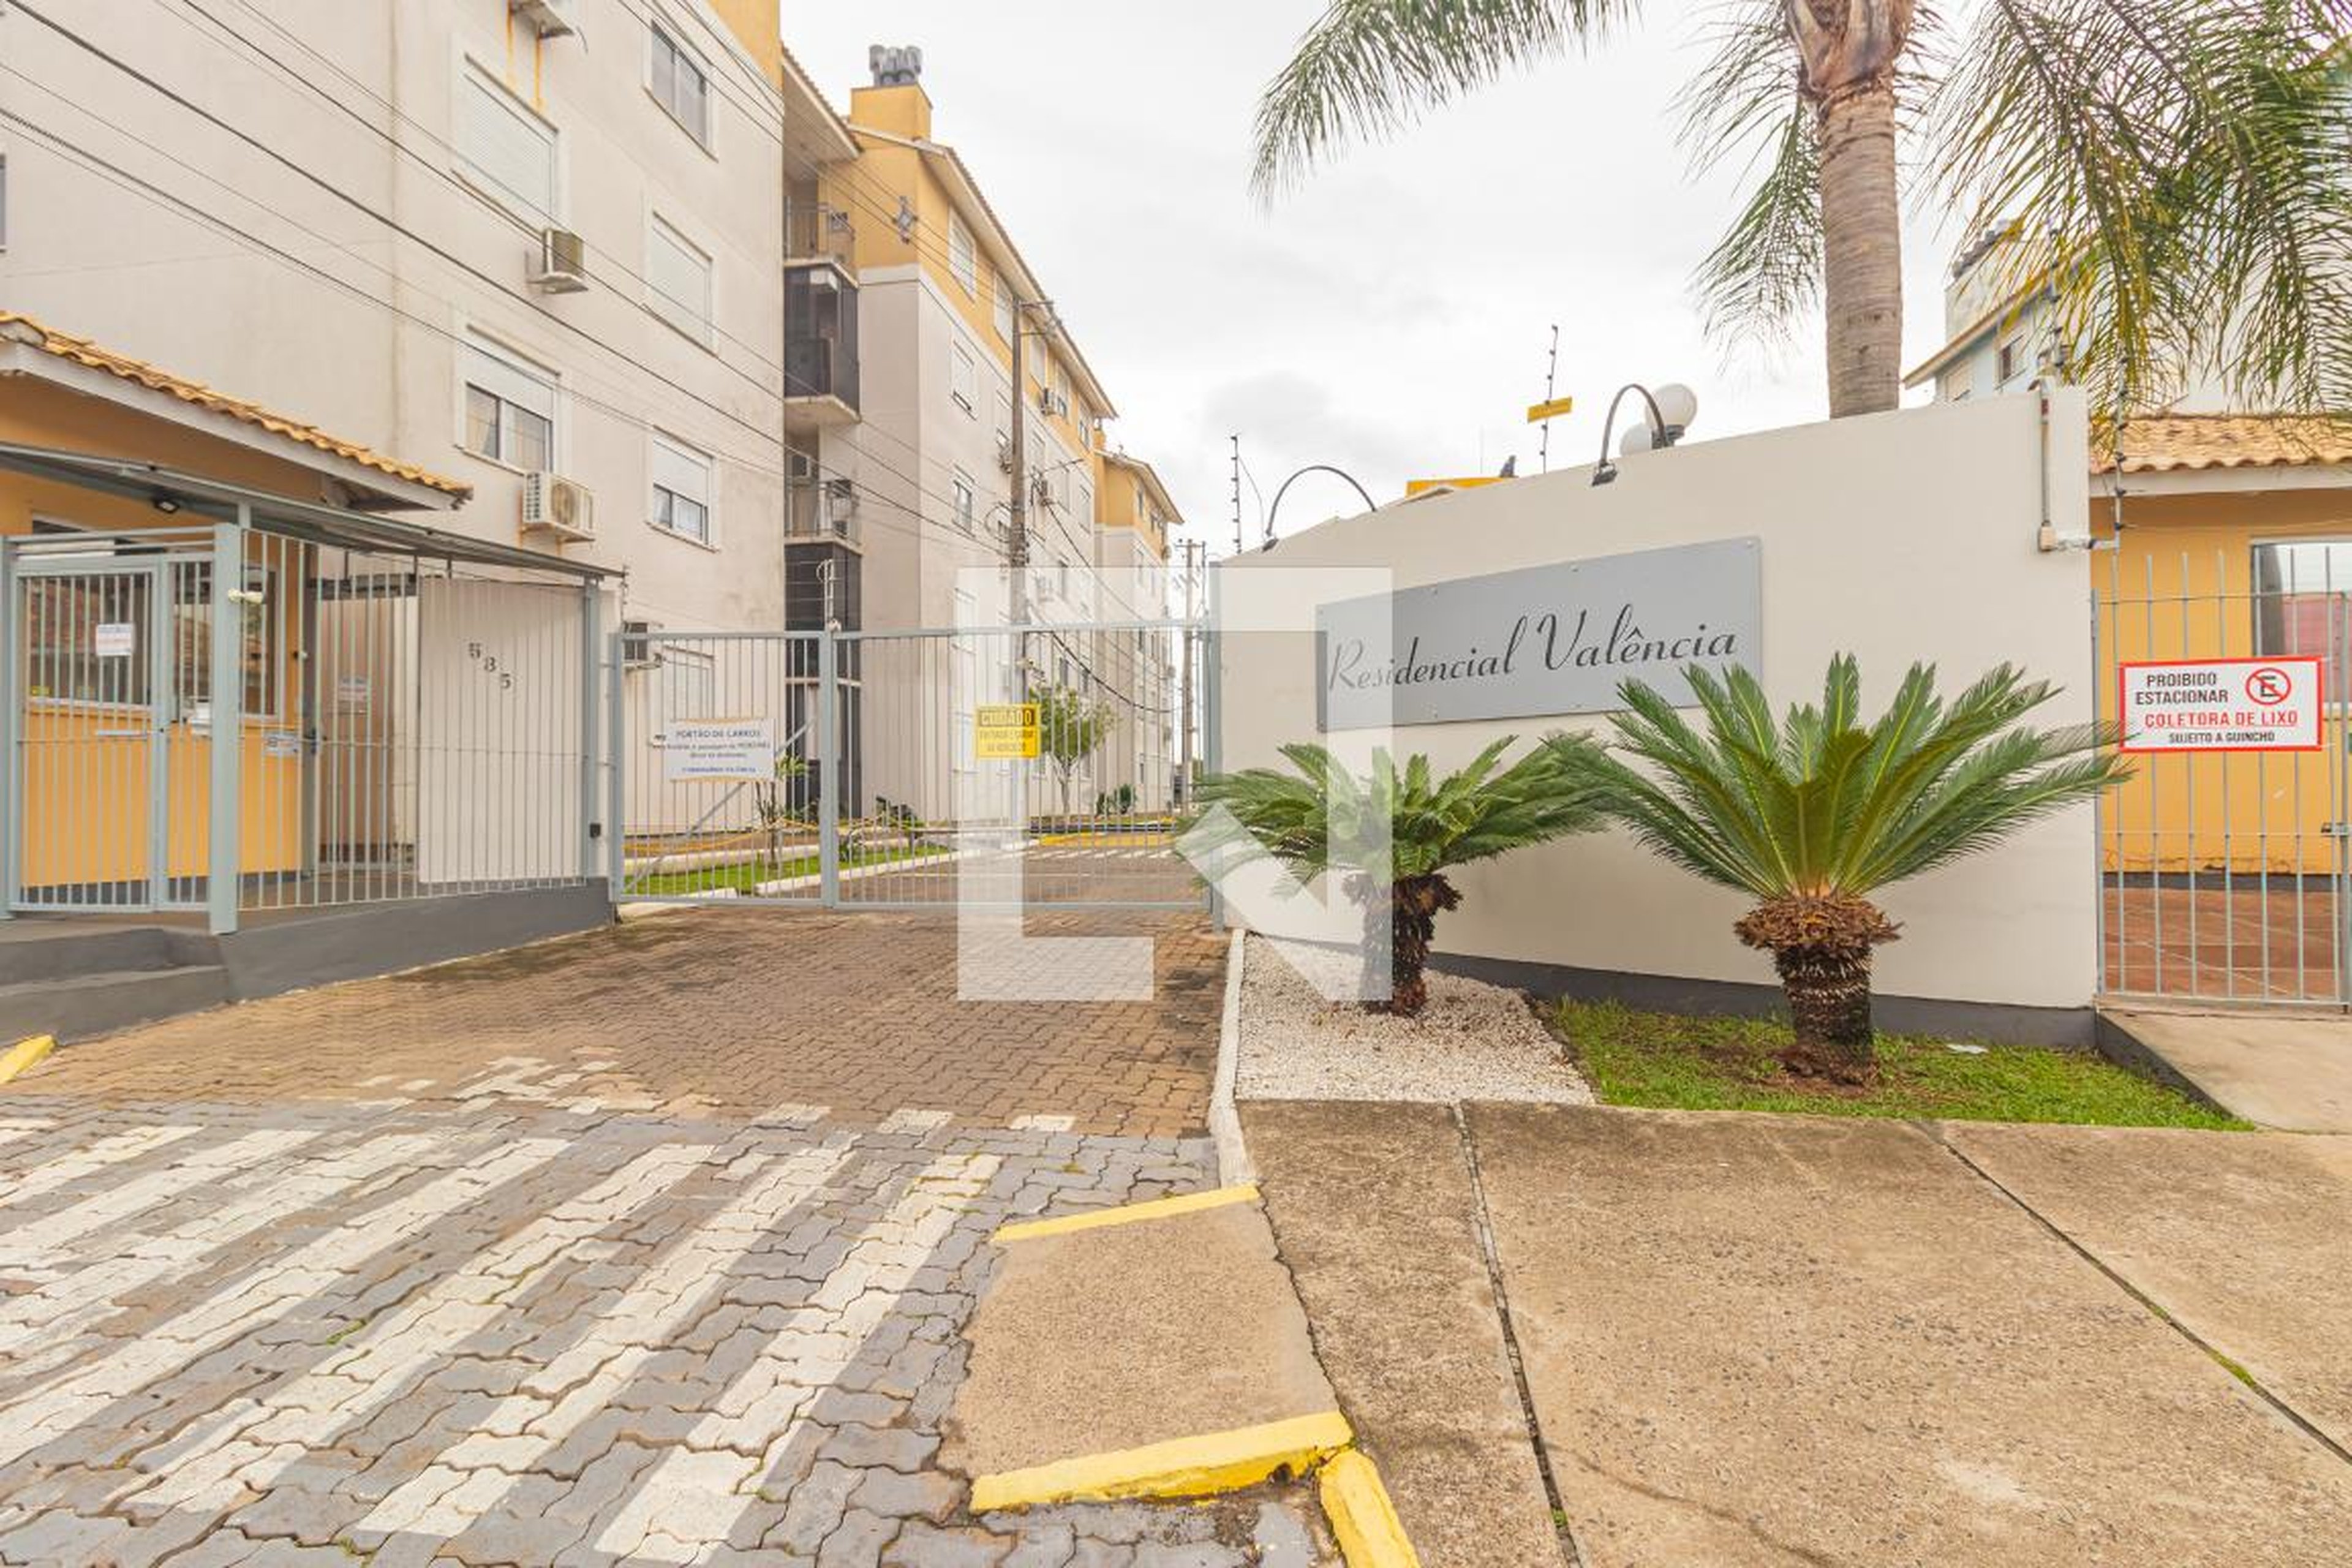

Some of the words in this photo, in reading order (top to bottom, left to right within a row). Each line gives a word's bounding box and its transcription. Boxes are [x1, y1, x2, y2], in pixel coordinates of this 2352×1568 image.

[1330, 615, 1528, 692] Residencial
[1537, 604, 1736, 671] Valência
[2146, 672, 2217, 687] PROIBIDO
[2135, 689, 2228, 705] ESTACIONAR
[2144, 710, 2230, 728] COLETORA
[2235, 711, 2255, 726] DE
[2261, 709, 2297, 725] LIXO
[2169, 733, 2212, 744] SUJEITO
[2215, 732, 2224, 742] A
[2225, 731, 2275, 742] GUINCHO
